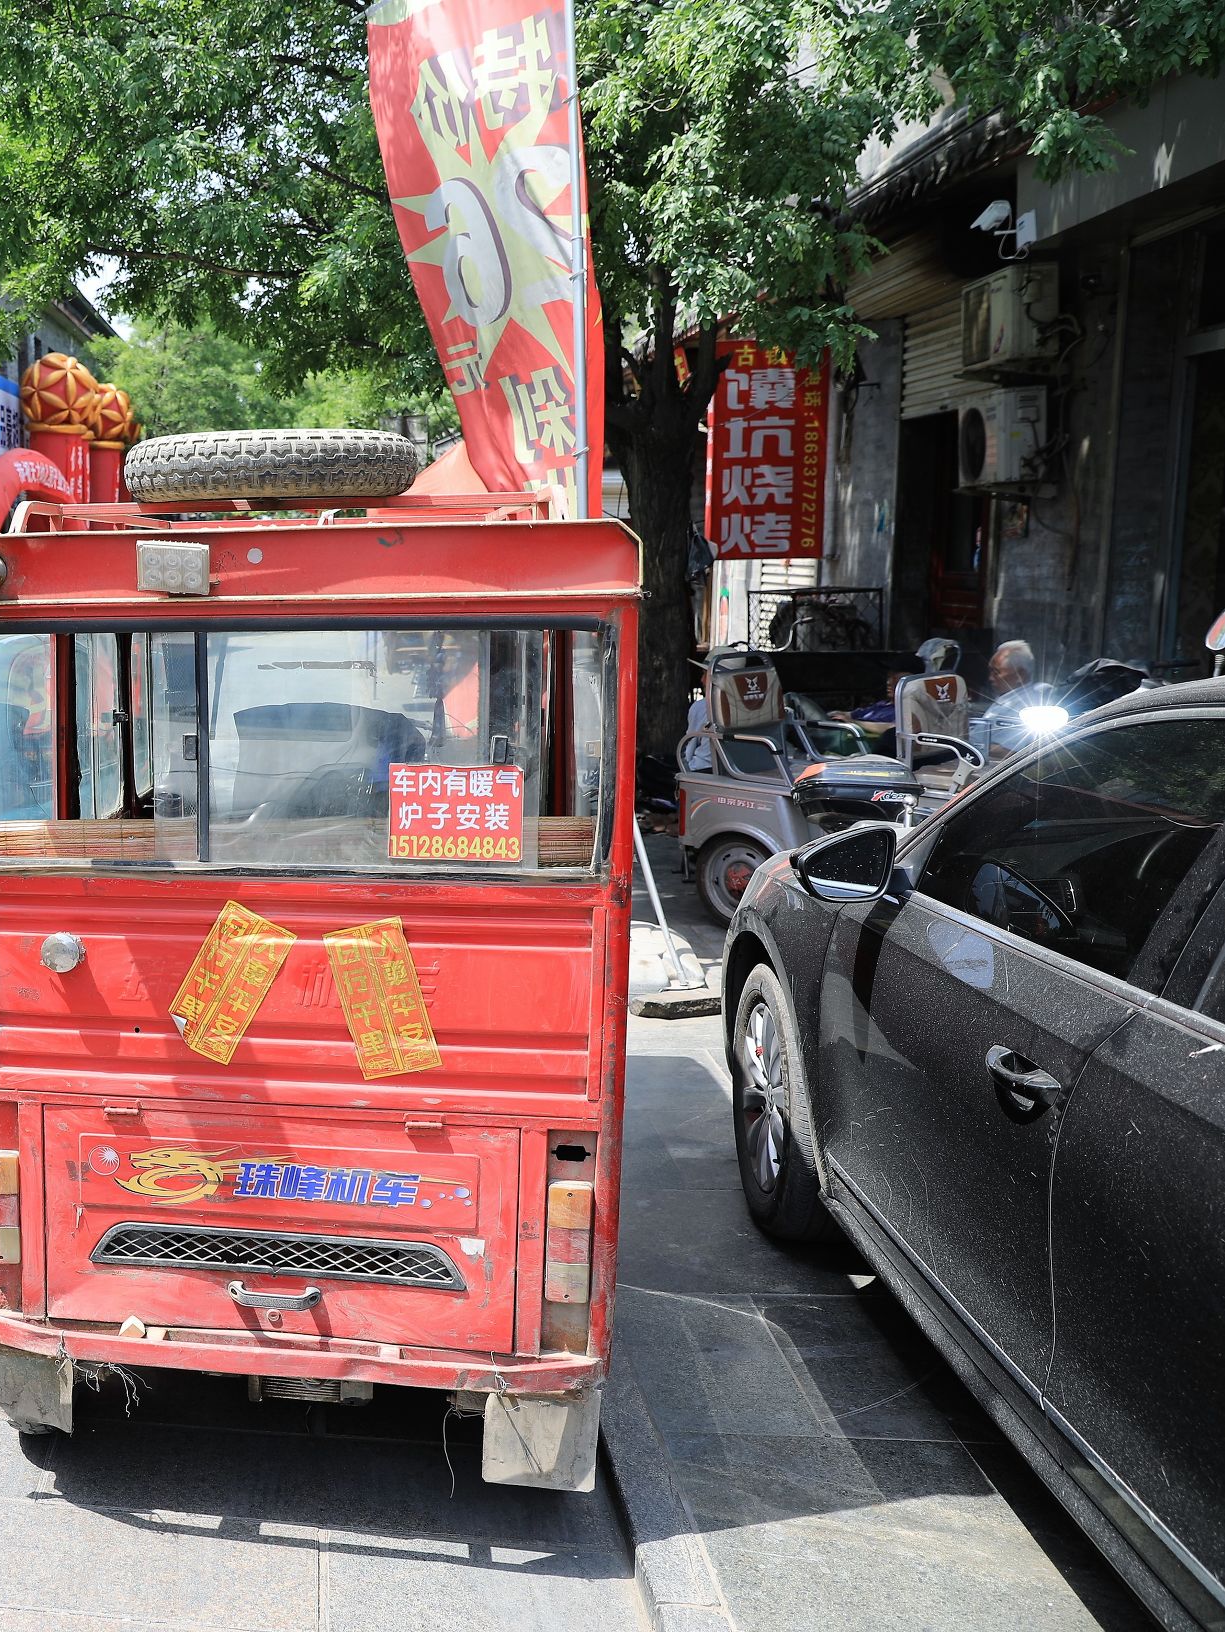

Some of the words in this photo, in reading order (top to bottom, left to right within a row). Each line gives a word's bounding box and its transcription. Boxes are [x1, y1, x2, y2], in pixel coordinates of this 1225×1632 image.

[721, 368, 796, 554] 馕坑烧烤
[392, 768, 520, 798] 车内有暖气
[399, 802, 509, 831] 炉子安装
[391, 835, 520, 859] 15128684843
[334, 940, 388, 1057] 日行千里
[233, 1162, 422, 1207] 珠峰机车
